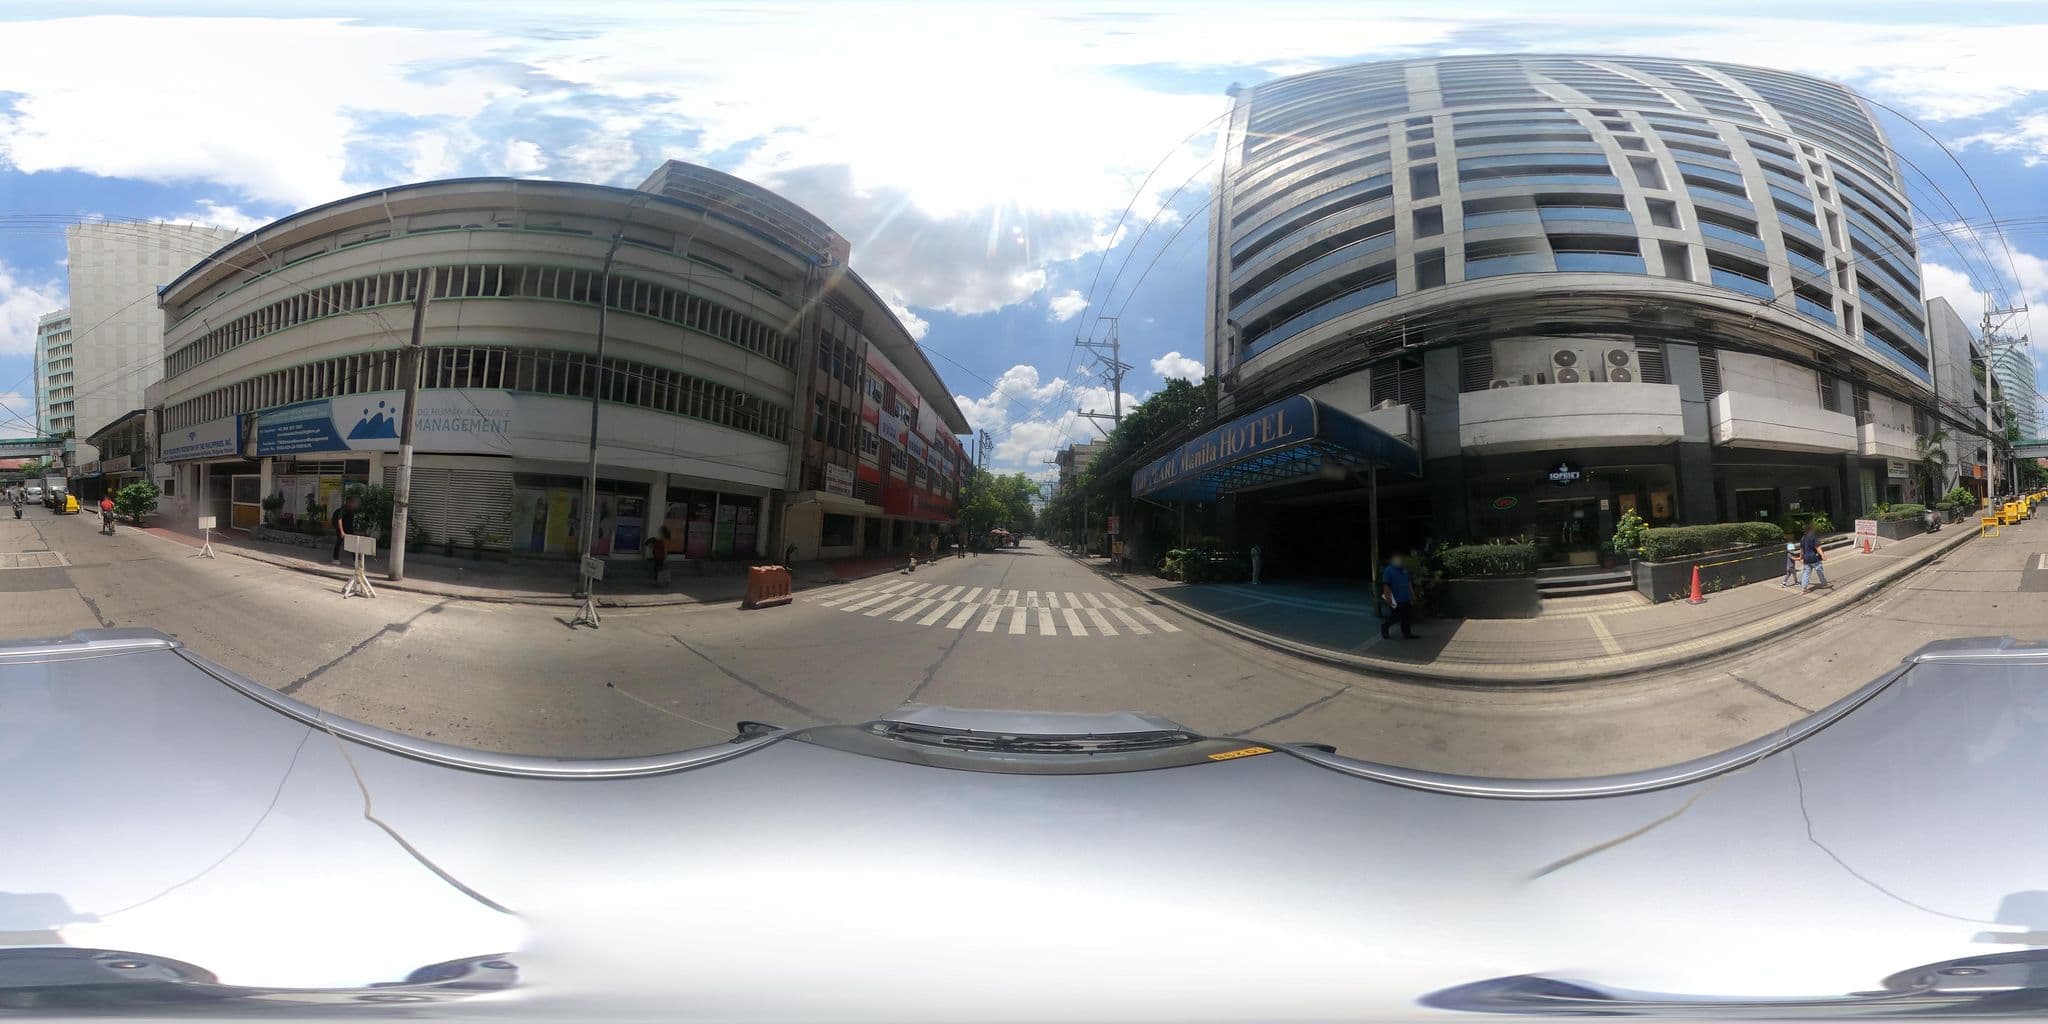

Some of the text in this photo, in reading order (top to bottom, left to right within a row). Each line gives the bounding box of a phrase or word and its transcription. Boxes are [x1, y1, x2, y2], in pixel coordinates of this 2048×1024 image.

[431, 408, 463, 417] HUMAN
[415, 417, 511, 433] MANAGEMENT
[1181, 441, 1217, 472] Manila
[1219, 408, 1294, 458] HOTEL
